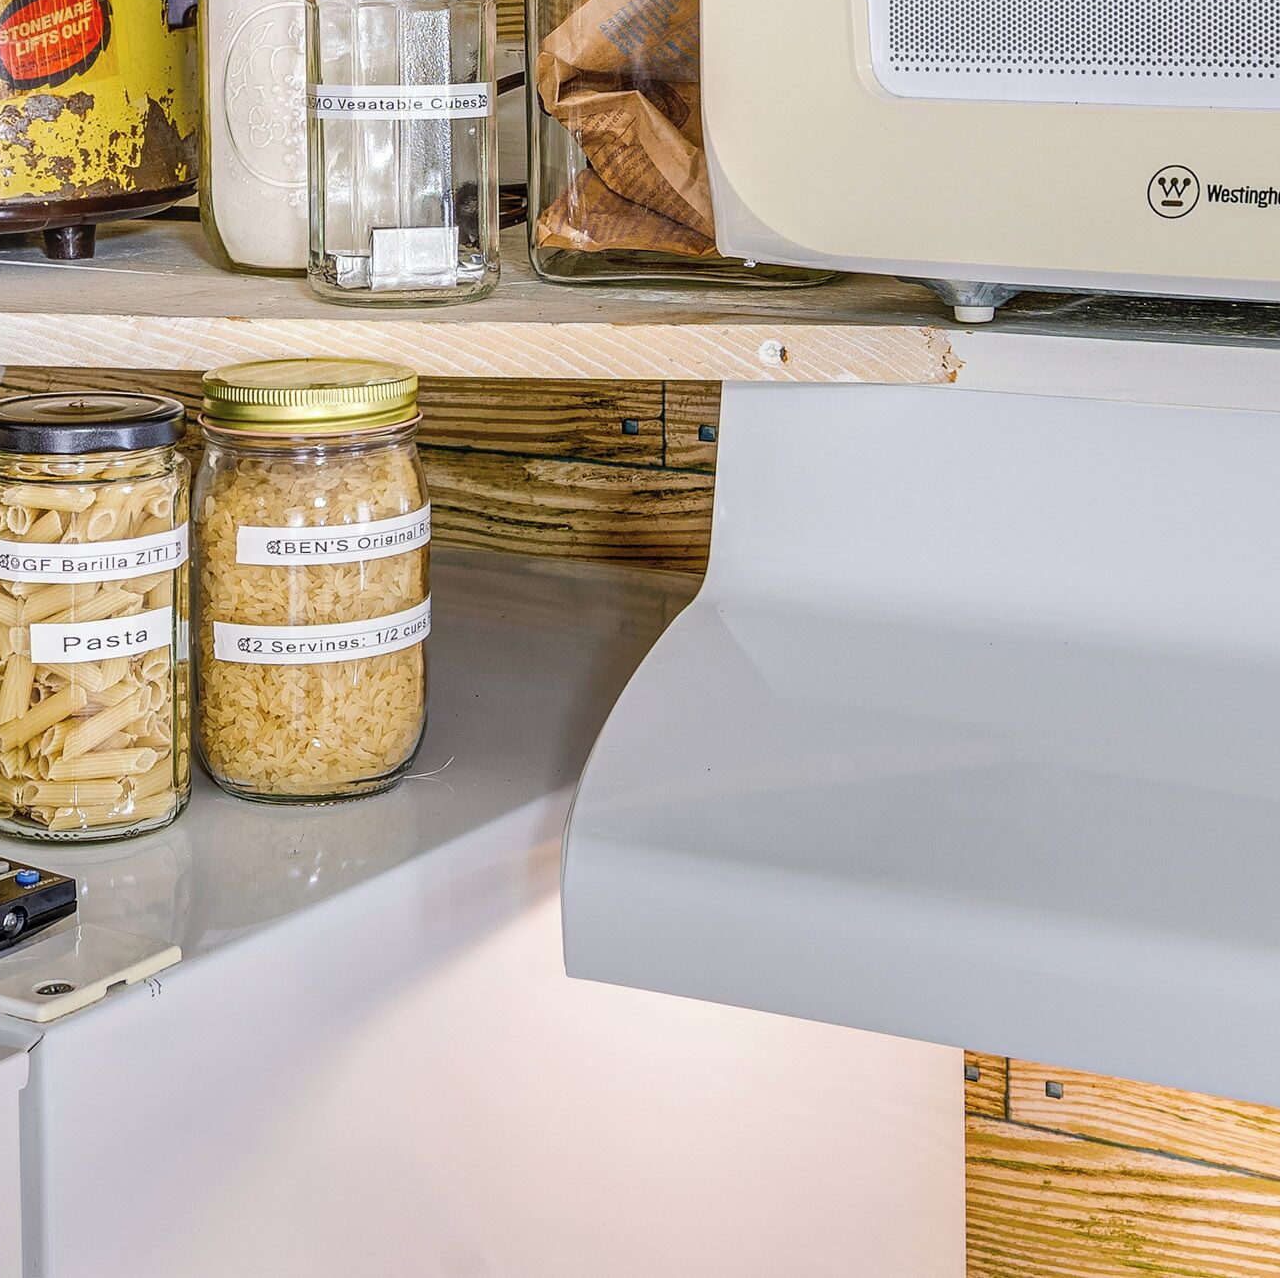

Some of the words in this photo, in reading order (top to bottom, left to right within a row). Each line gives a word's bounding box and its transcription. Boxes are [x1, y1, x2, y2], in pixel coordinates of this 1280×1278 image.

[15, 29, 59, 57] LIFTS
[61, 17, 91, 40] OUT
[430, 96, 477, 109] Cubes
[283, 538, 350, 555] BEN'S
[357, 526, 417, 550] Original
[22, 558, 52, 572] GF
[62, 553, 128, 572] Barilla
[135, 546, 169, 566] ZITI
[63, 629, 148, 653] Pasta
[271, 636, 367, 654] Servings:
[375, 627, 399, 645] 1/2
